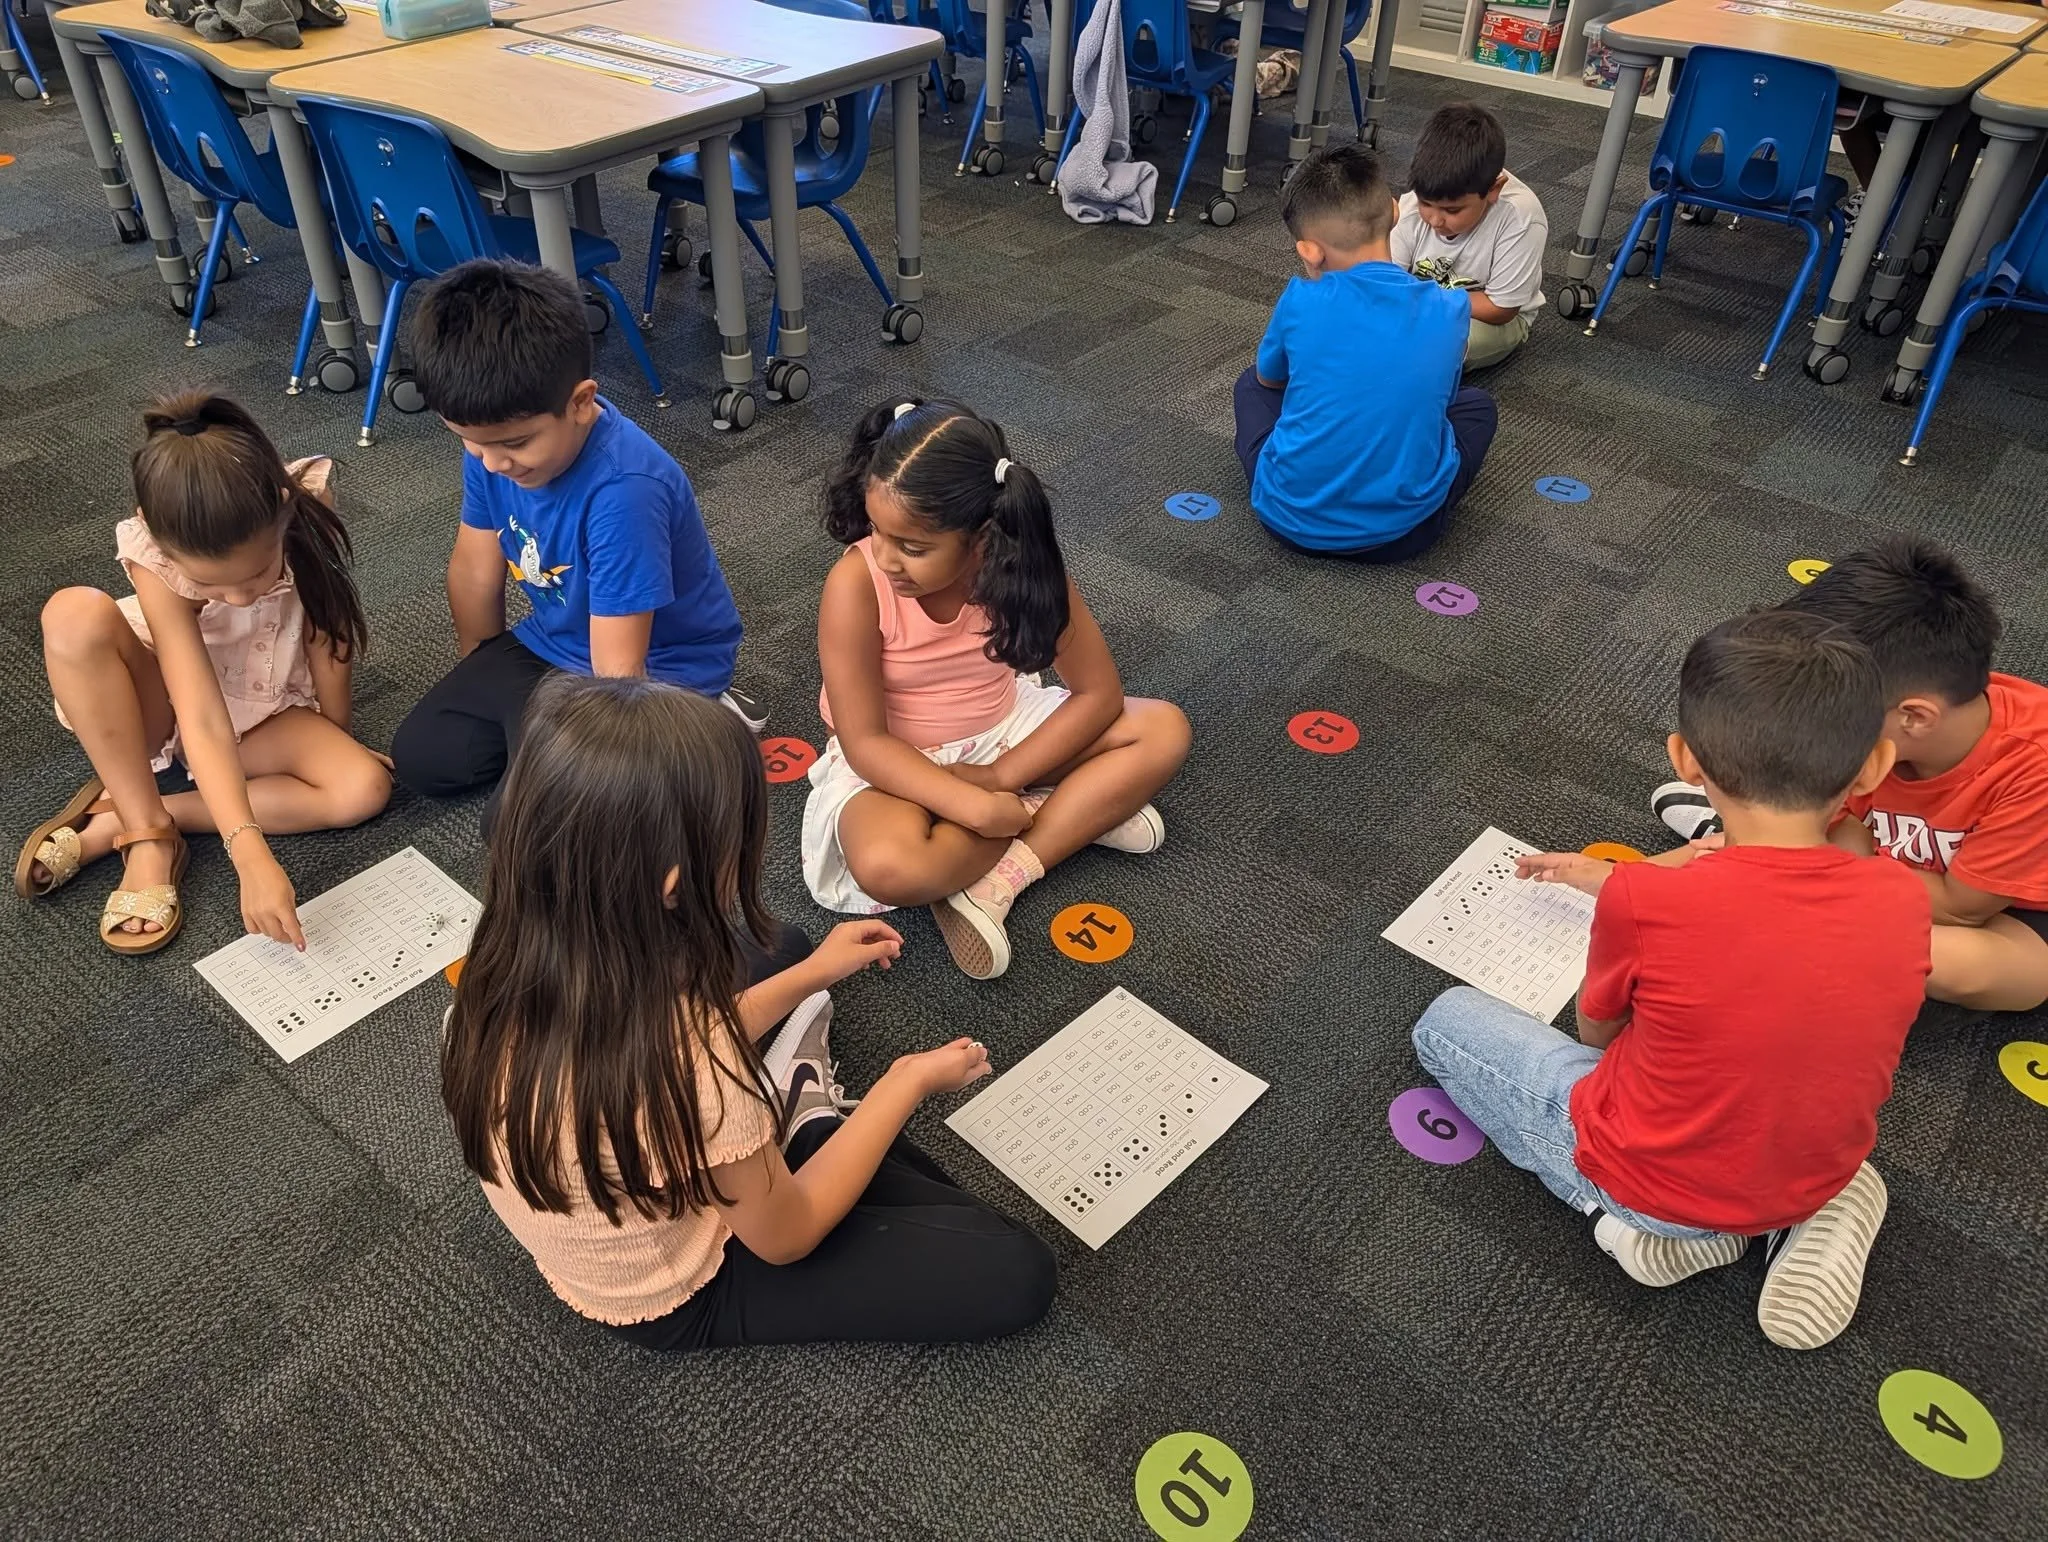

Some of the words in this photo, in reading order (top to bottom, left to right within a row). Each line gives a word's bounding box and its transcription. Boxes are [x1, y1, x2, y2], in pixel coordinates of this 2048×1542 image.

[1546, 479, 1577, 498] 11
[1178, 496, 1209, 517] 17
[1427, 585, 1466, 610] 12
[1303, 716, 1345, 745] 13
[395, 864, 413, 875] nab
[363, 882, 380, 893] tap
[415, 879, 429, 890] jab
[371, 890, 389, 902] dab
[422, 887, 440, 899] gag
[330, 900, 346, 911] rap
[380, 897, 399, 909] max
[434, 896, 449, 906] hat
[339, 908, 356, 920] sad
[392, 906, 407, 916] lap
[445, 905, 455, 913] at
[348, 916, 365, 929] mat
[399, 913, 419, 926] bag
[304, 928, 321, 938] rag
[358, 925, 374, 937] fad
[410, 923, 427, 933] has
[1065, 911, 1118, 952] 14
[313, 935, 332, 947] wax
[368, 934, 384, 944] lab
[268, 946, 287, 959] yap
[322, 944, 341, 956] cab
[377, 942, 392, 953] cat
[227, 960, 237, 969] at
[278, 955, 298, 967] zap
[335, 954, 348, 964] fat
[233, 968, 250, 979] vat
[285, 963, 307, 977] map
[341, 961, 360, 975] had
[408, 968, 423, 978] Roll
[240, 976, 260, 989] dad
[296, 973, 313, 985] gas
[392, 976, 409, 987] and
[250, 985, 268, 997] tag
[308, 983, 320, 992] as
[372, 986, 393, 1000] Read
[257, 992, 279, 1008] mad
[267, 1002, 289, 1017] bad
[1115, 1007, 1131, 1020] nab
[1131, 1020, 1142, 1028] ax
[1091, 1029, 1106, 1040] tap
[1144, 1027, 1157, 1040] jab
[1103, 1038, 1119, 1052] dab
[1156, 1037, 1173, 1051] gag
[1064, 1049, 1079, 1061] rap
[1117, 1048, 1134, 1062] max
[1173, 1048, 1187, 1061] hat
[1077, 1060, 1092, 1074] sad
[1133, 1060, 1148, 1072] lap
[1189, 1061, 1199, 1070] at
[1035, 1069, 1052, 1084] gap
[1091, 1071, 1107, 1085] mat
[1144, 1070, 1163, 1084] bag
[1049, 1082, 1065, 1094] rag
[1106, 1082, 1121, 1095] fad
[1160, 1081, 1176, 1094] has
[1008, 1093, 1025, 1107] bat
[1063, 1093, 1080, 1107] wax
[1121, 1093, 1135, 1104] lab
[1022, 1103, 1038, 1118] yap
[1077, 1103, 1094, 1117] cab
[1135, 1103, 1149, 1116] cat
[981, 1118, 992, 1128] at
[1036, 1115, 1052, 1129] zap
[1094, 1116, 1108, 1128] fat
[1417, 1108, 1460, 1141] 9
[993, 1129, 1008, 1141] vat
[1048, 1126, 1067, 1142] map
[1106, 1125, 1125, 1141] had
[1005, 1139, 1023, 1155] dad
[1064, 1138, 1079, 1153] gas
[1183, 1138, 1197, 1150] Roll
[1020, 1151, 1037, 1165] tag
[1080, 1152, 1092, 1163] as
[1170, 1148, 1186, 1161] and
[1033, 1161, 1053, 1180] mad
[1154, 1159, 1173, 1176] Read
[1048, 1174, 1068, 1191] bad
[1914, 1403, 1967, 1444] 4
[1160, 1447, 1233, 1529] 10
